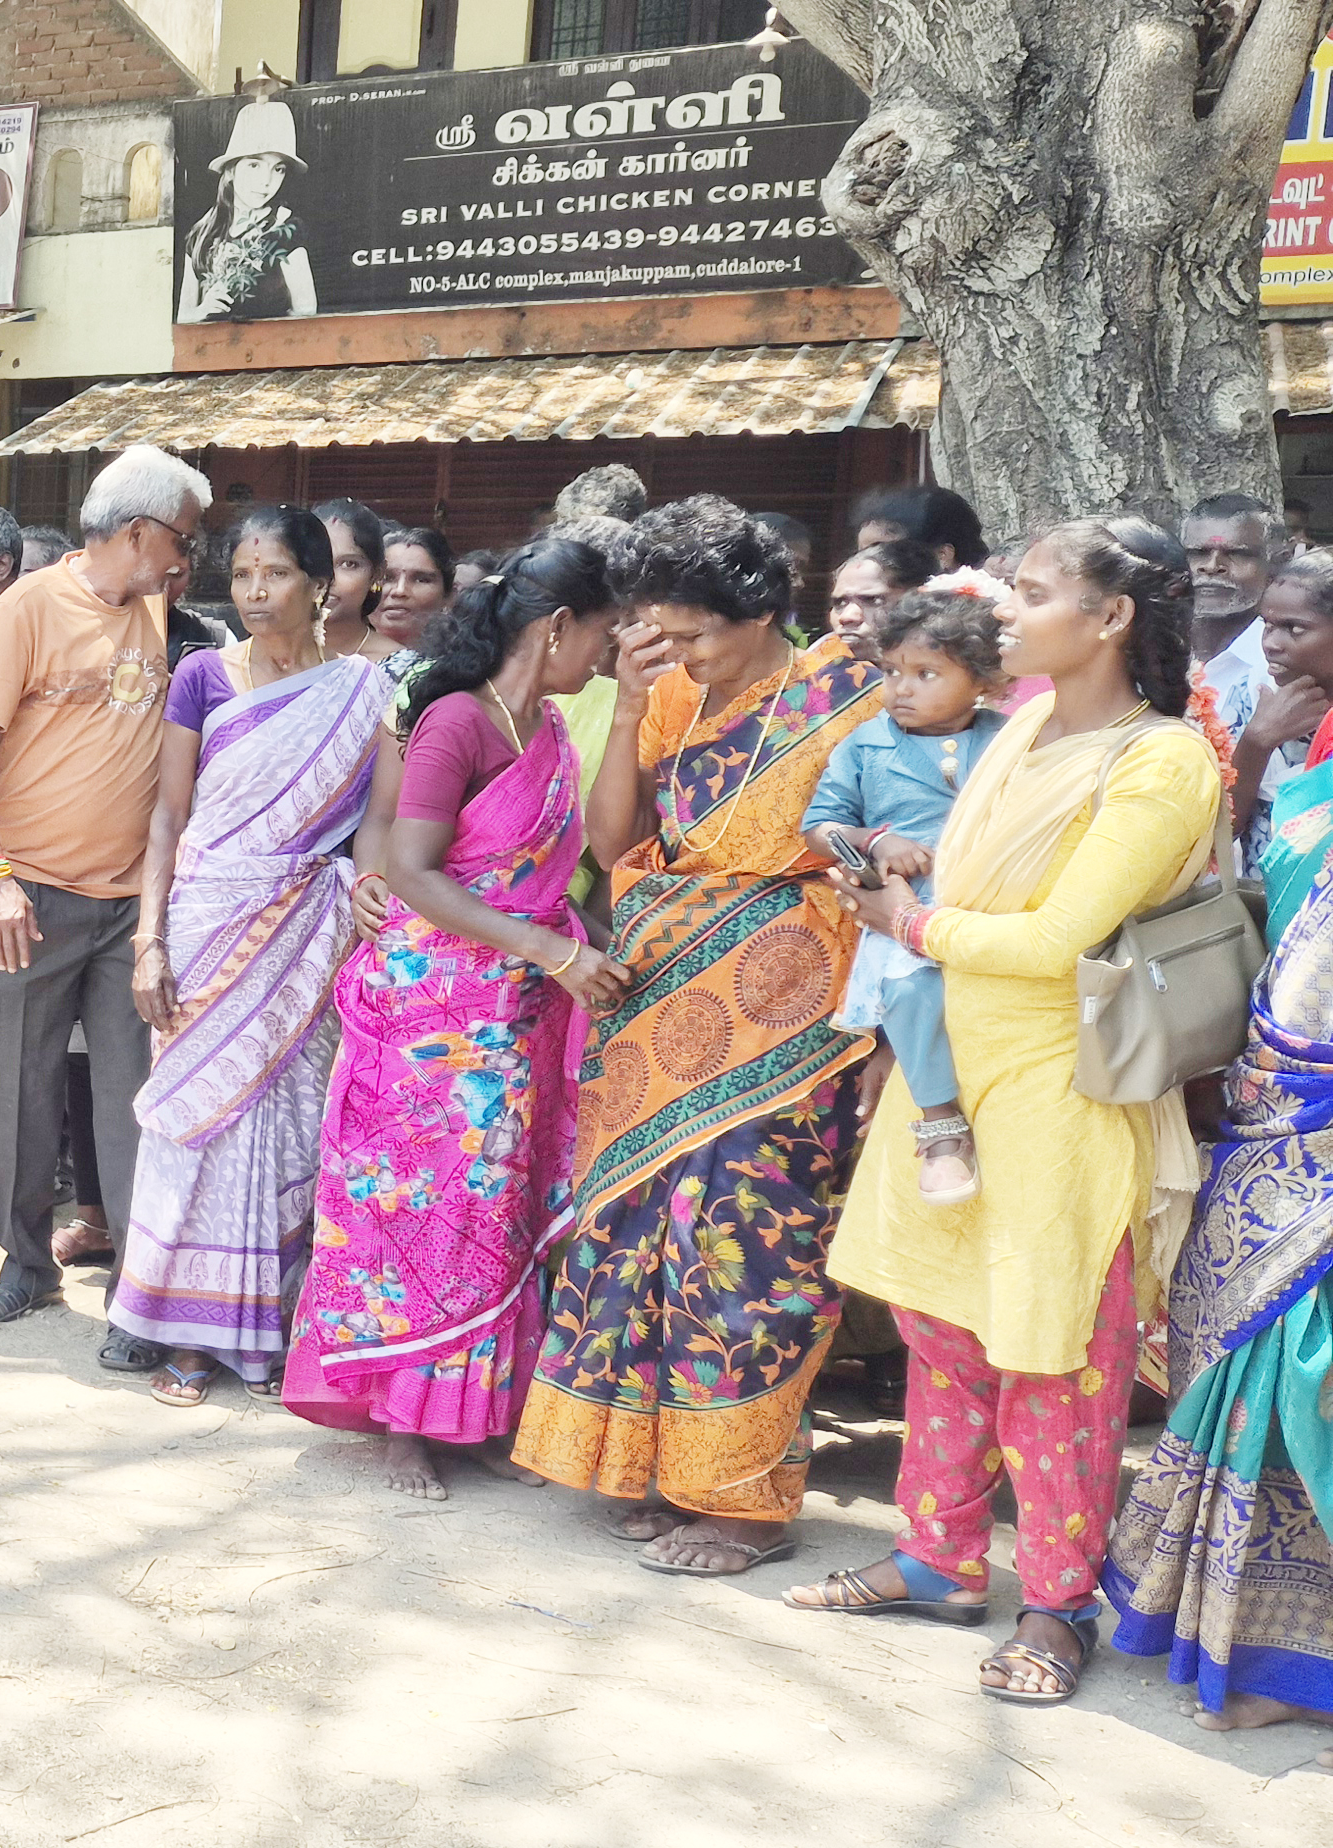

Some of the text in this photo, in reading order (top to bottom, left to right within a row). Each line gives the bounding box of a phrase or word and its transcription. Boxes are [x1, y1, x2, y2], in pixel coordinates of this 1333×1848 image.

[584, 59, 624, 75] வள்ளி
[435, 72, 785, 150] ஸ்ரீ வள்ளி
[492, 135, 753, 187] சிக்கன் கார்னர்
[400, 205, 447, 226] SRI
[460, 199, 544, 222] VALLI
[556, 188, 693, 214] CHICKEN
[351, 215, 837, 267] CELL:9443055439-94427463
[1262, 216, 1322, 248] RINT
[409, 272, 490, 294] NO-5-ALC
[1261, 267, 1333, 286] omplex
